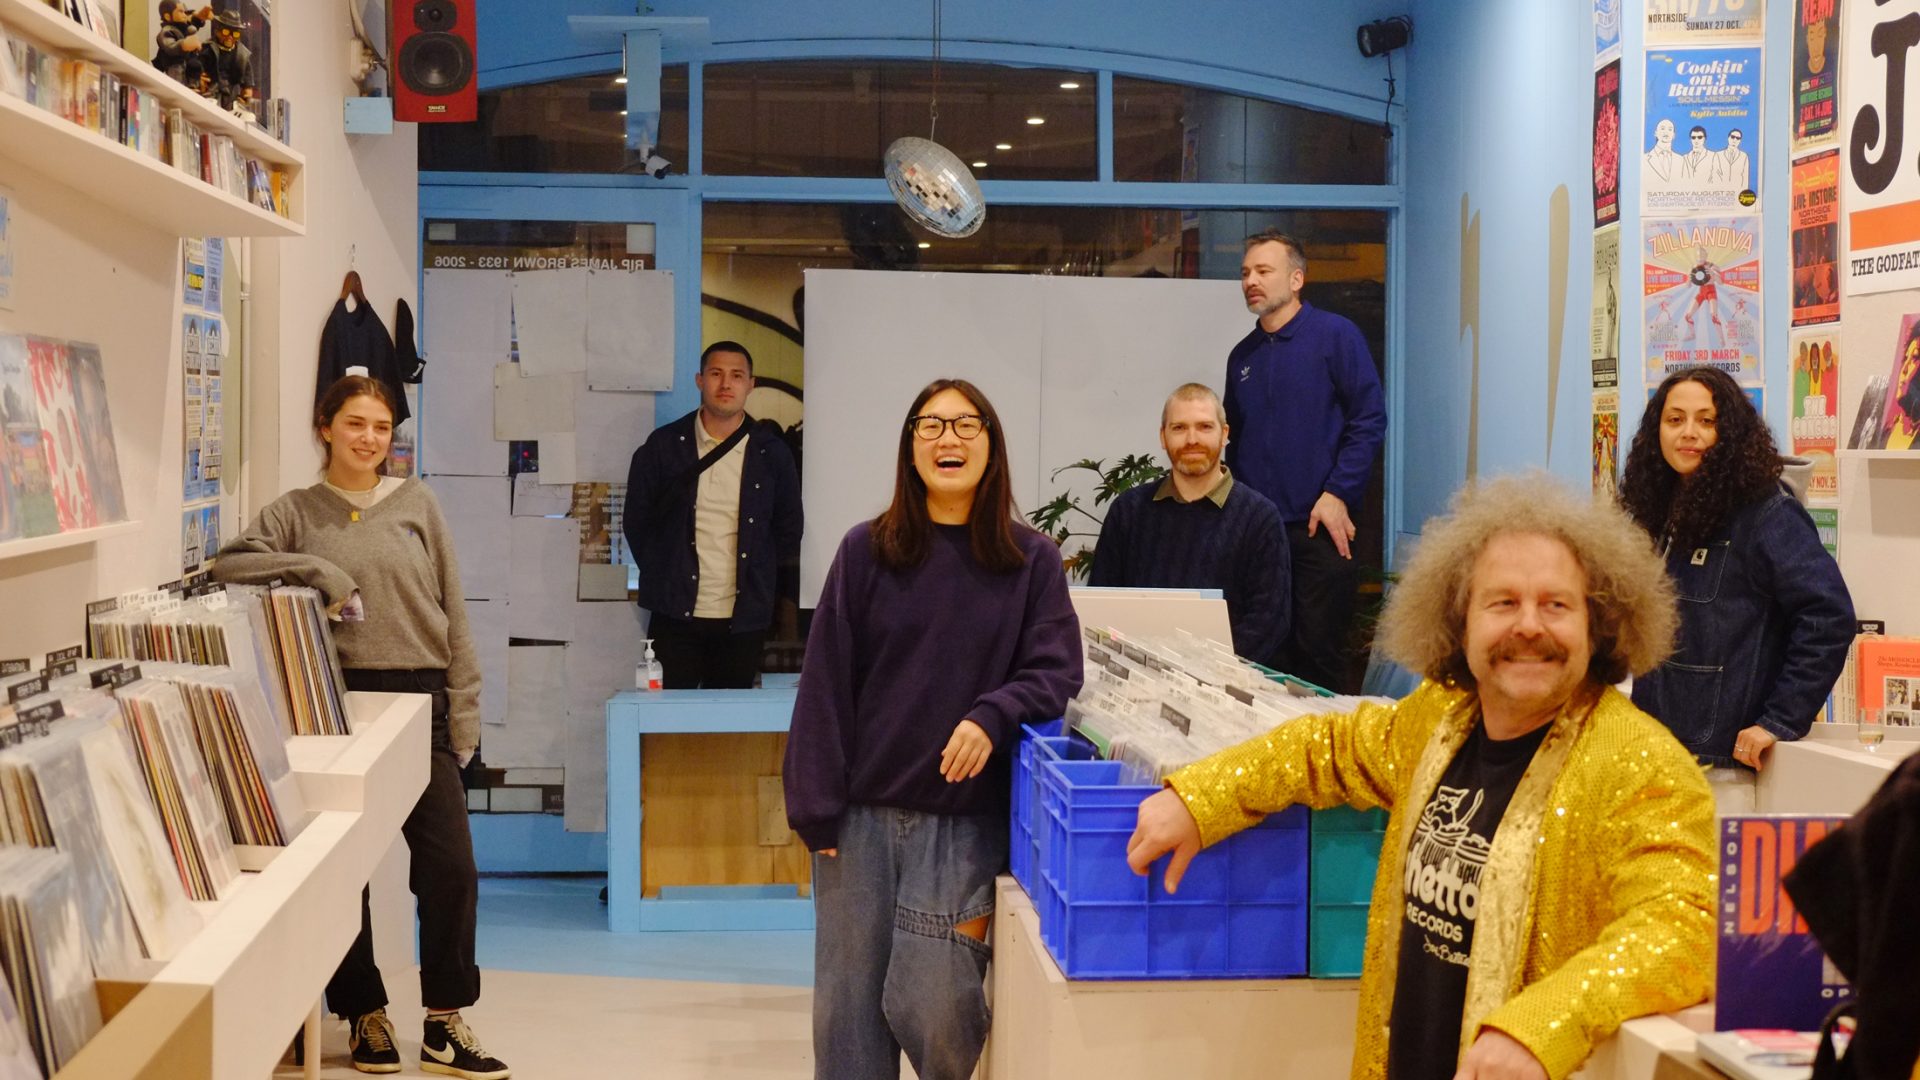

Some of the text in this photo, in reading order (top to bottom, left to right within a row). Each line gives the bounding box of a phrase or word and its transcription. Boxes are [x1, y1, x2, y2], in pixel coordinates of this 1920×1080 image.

[1648, 13, 1688, 24] NORTHSIDE
[1686, 21, 1713, 31] SUNDAY
[1715, 21, 1724, 30] 27
[1676, 59, 1748, 76] Cookin'
[1690, 73, 1727, 87] on 3
[1668, 83, 1750, 97] Burners
[1793, 185, 1837, 211] LIVE INSTORE
[1799, 205, 1831, 218] NORTHSIDE
[1801, 214, 1828, 226] RECORDS
[1647, 226, 1753, 259] ZILLANOVA
[1851, 250, 1920, 277] THE GODFAT
[1664, 348, 1740, 361] FRIDAY 3RD MARCH
[1724, 820, 1738, 935] NELSON
[1406, 902, 1464, 943] RECORDS
